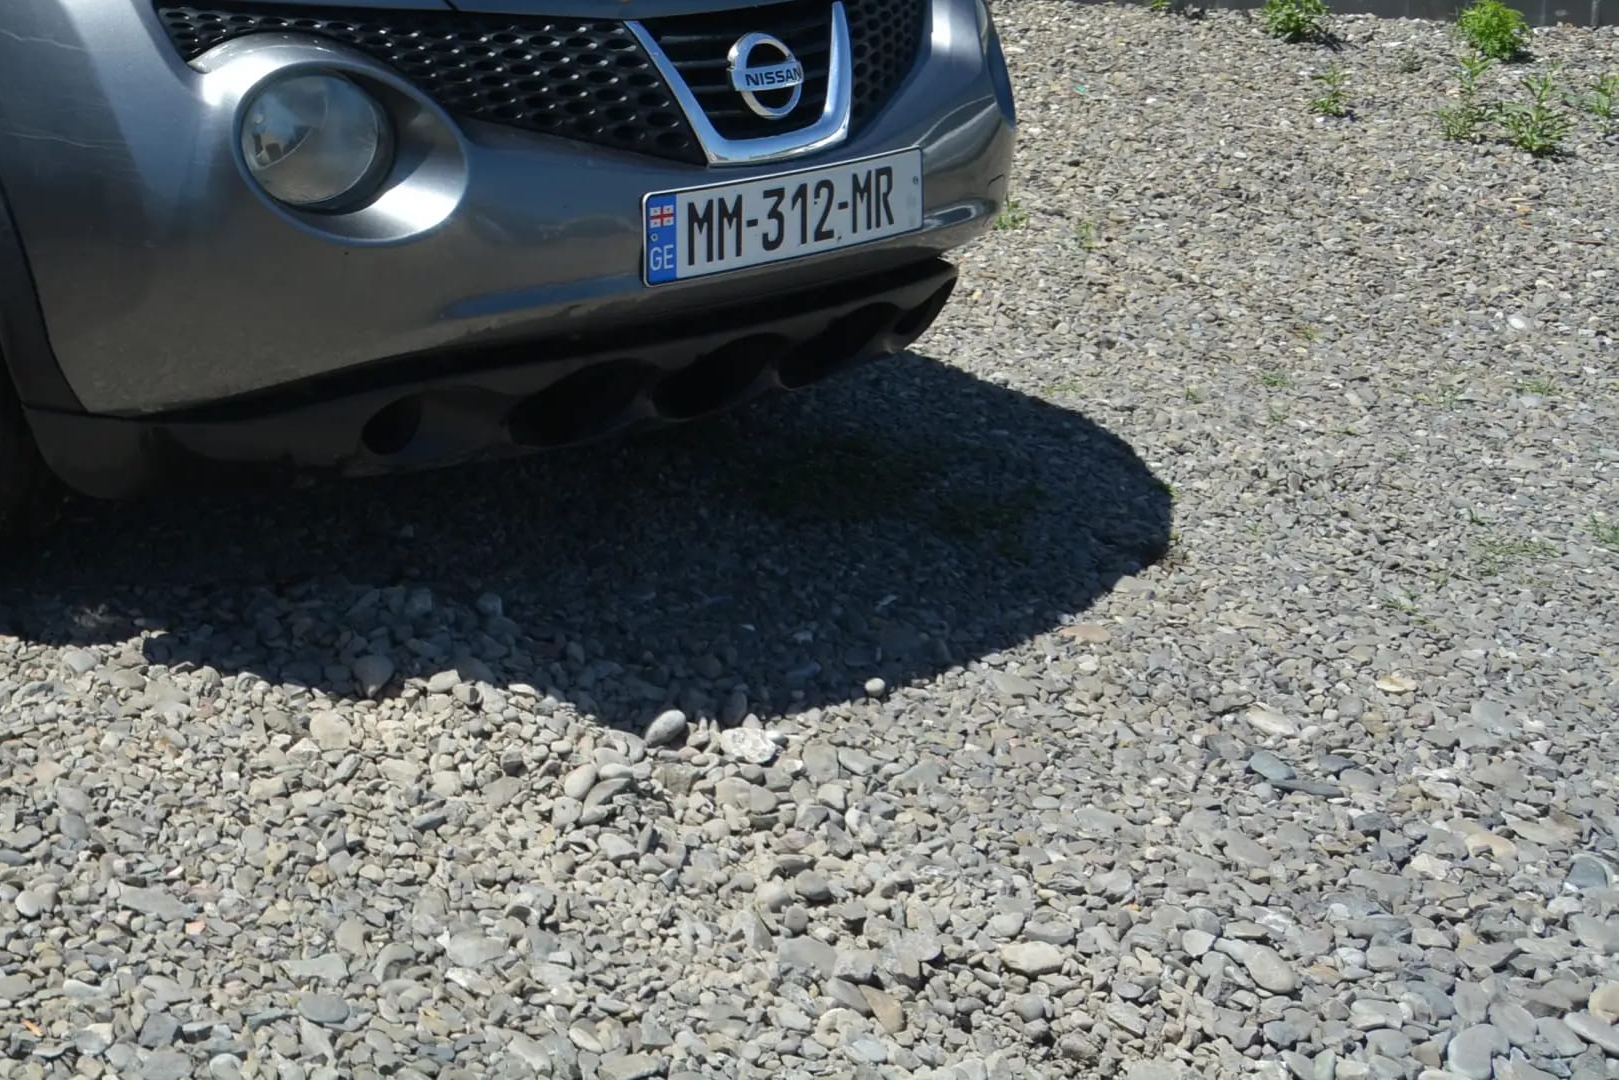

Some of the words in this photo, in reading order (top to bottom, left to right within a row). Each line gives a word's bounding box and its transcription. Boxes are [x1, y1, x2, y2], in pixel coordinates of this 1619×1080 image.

[744, 66, 802, 87] NISSAN
[687, 166, 895, 266] MM-312-MR
[649, 244, 675, 271] GE
